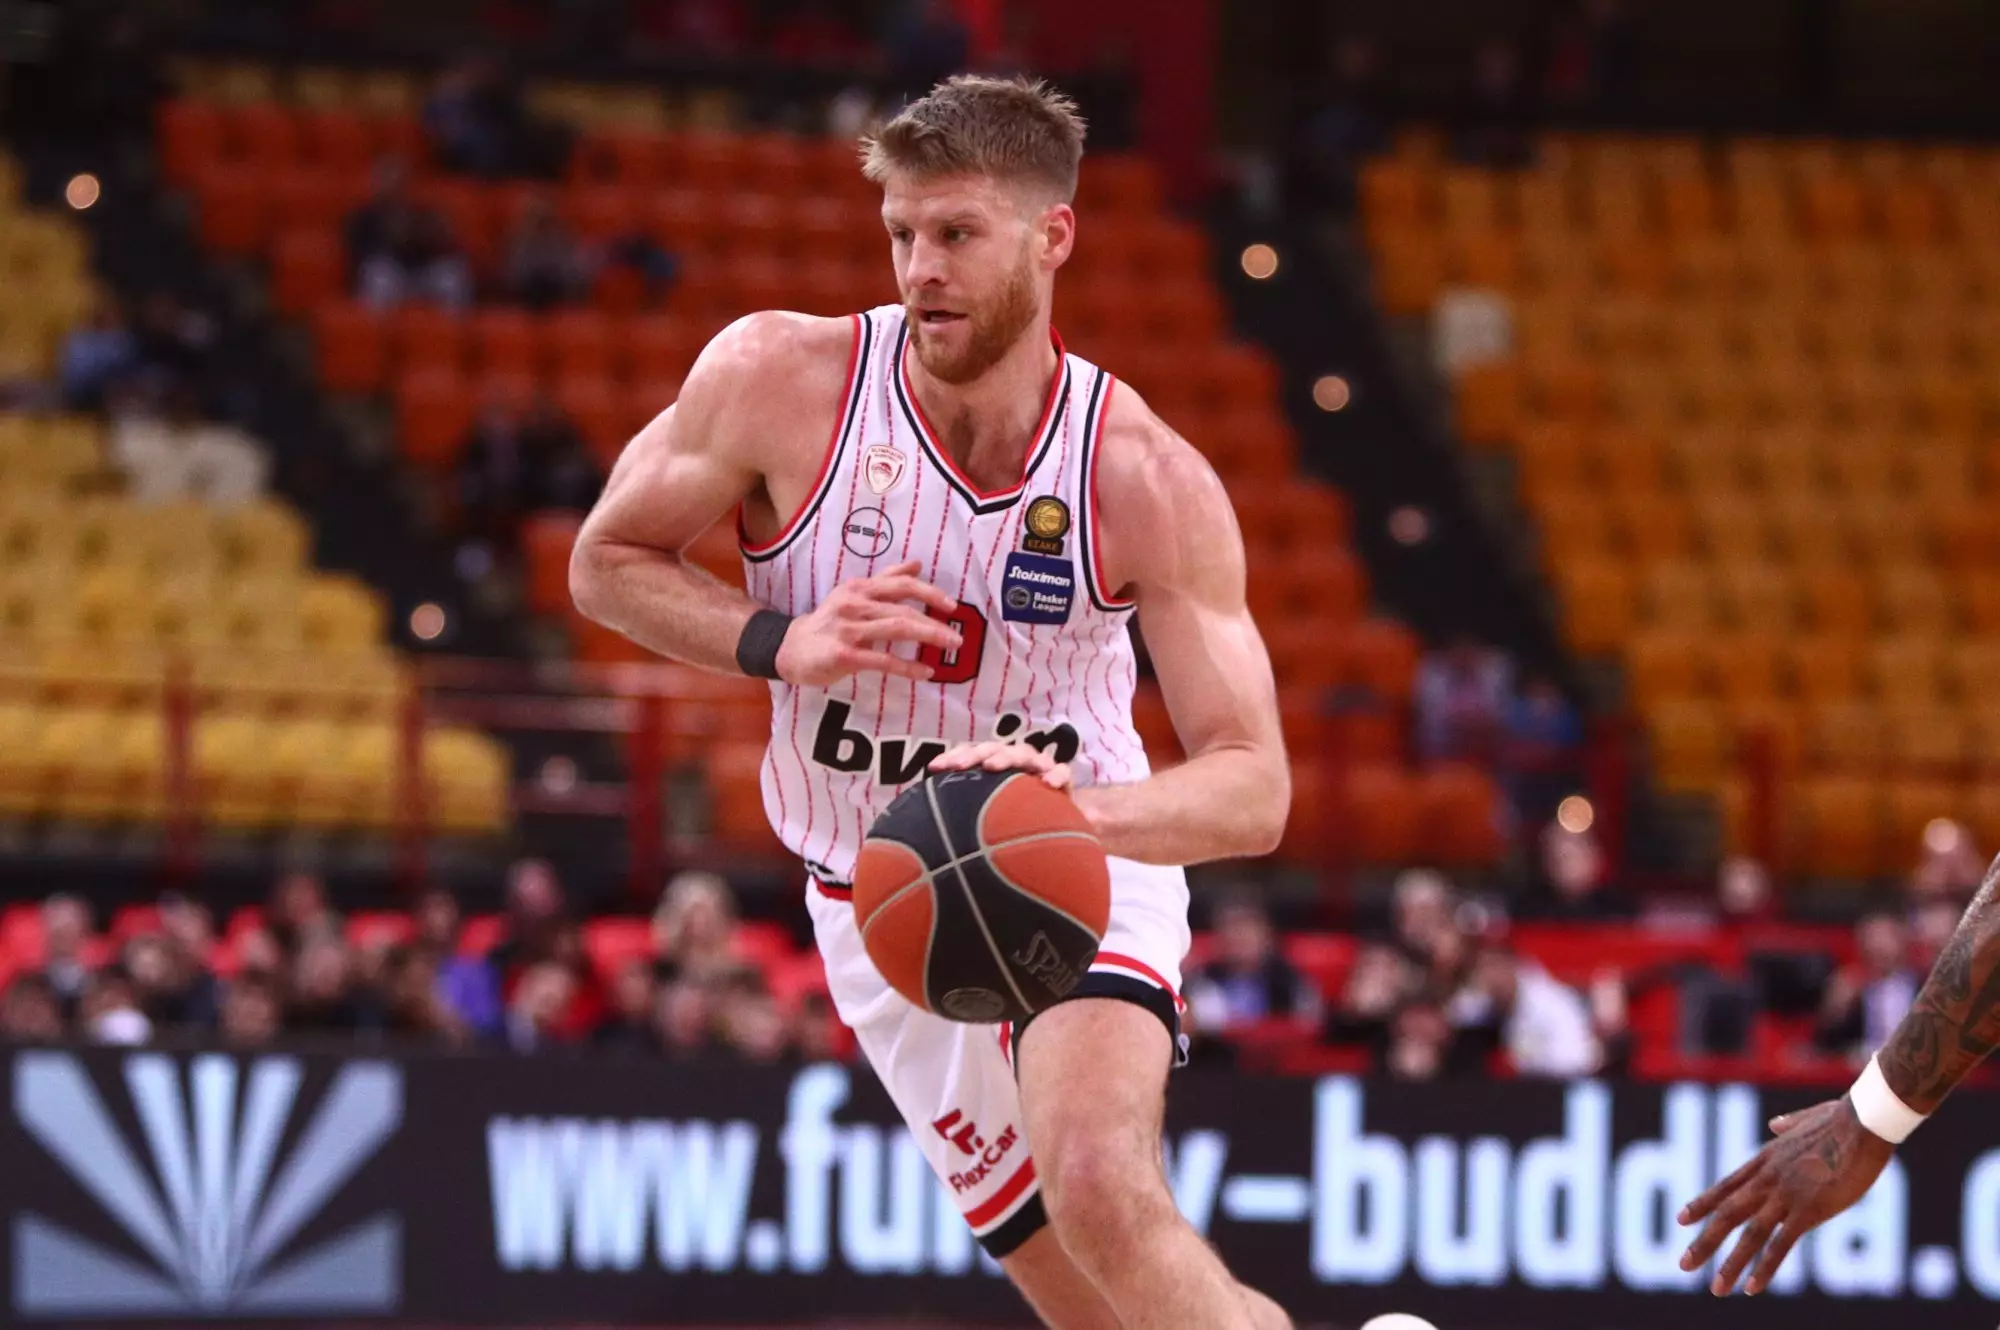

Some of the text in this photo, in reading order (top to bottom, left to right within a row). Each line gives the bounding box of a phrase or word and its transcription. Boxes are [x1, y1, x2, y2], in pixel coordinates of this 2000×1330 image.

[846, 524, 889, 541] GSA
[1008, 565, 1071, 587] Stoiximan
[1032, 600, 1066, 613] League
[1034, 591, 1068, 605] Basket
[949, 1123, 1019, 1195] FlexCar
